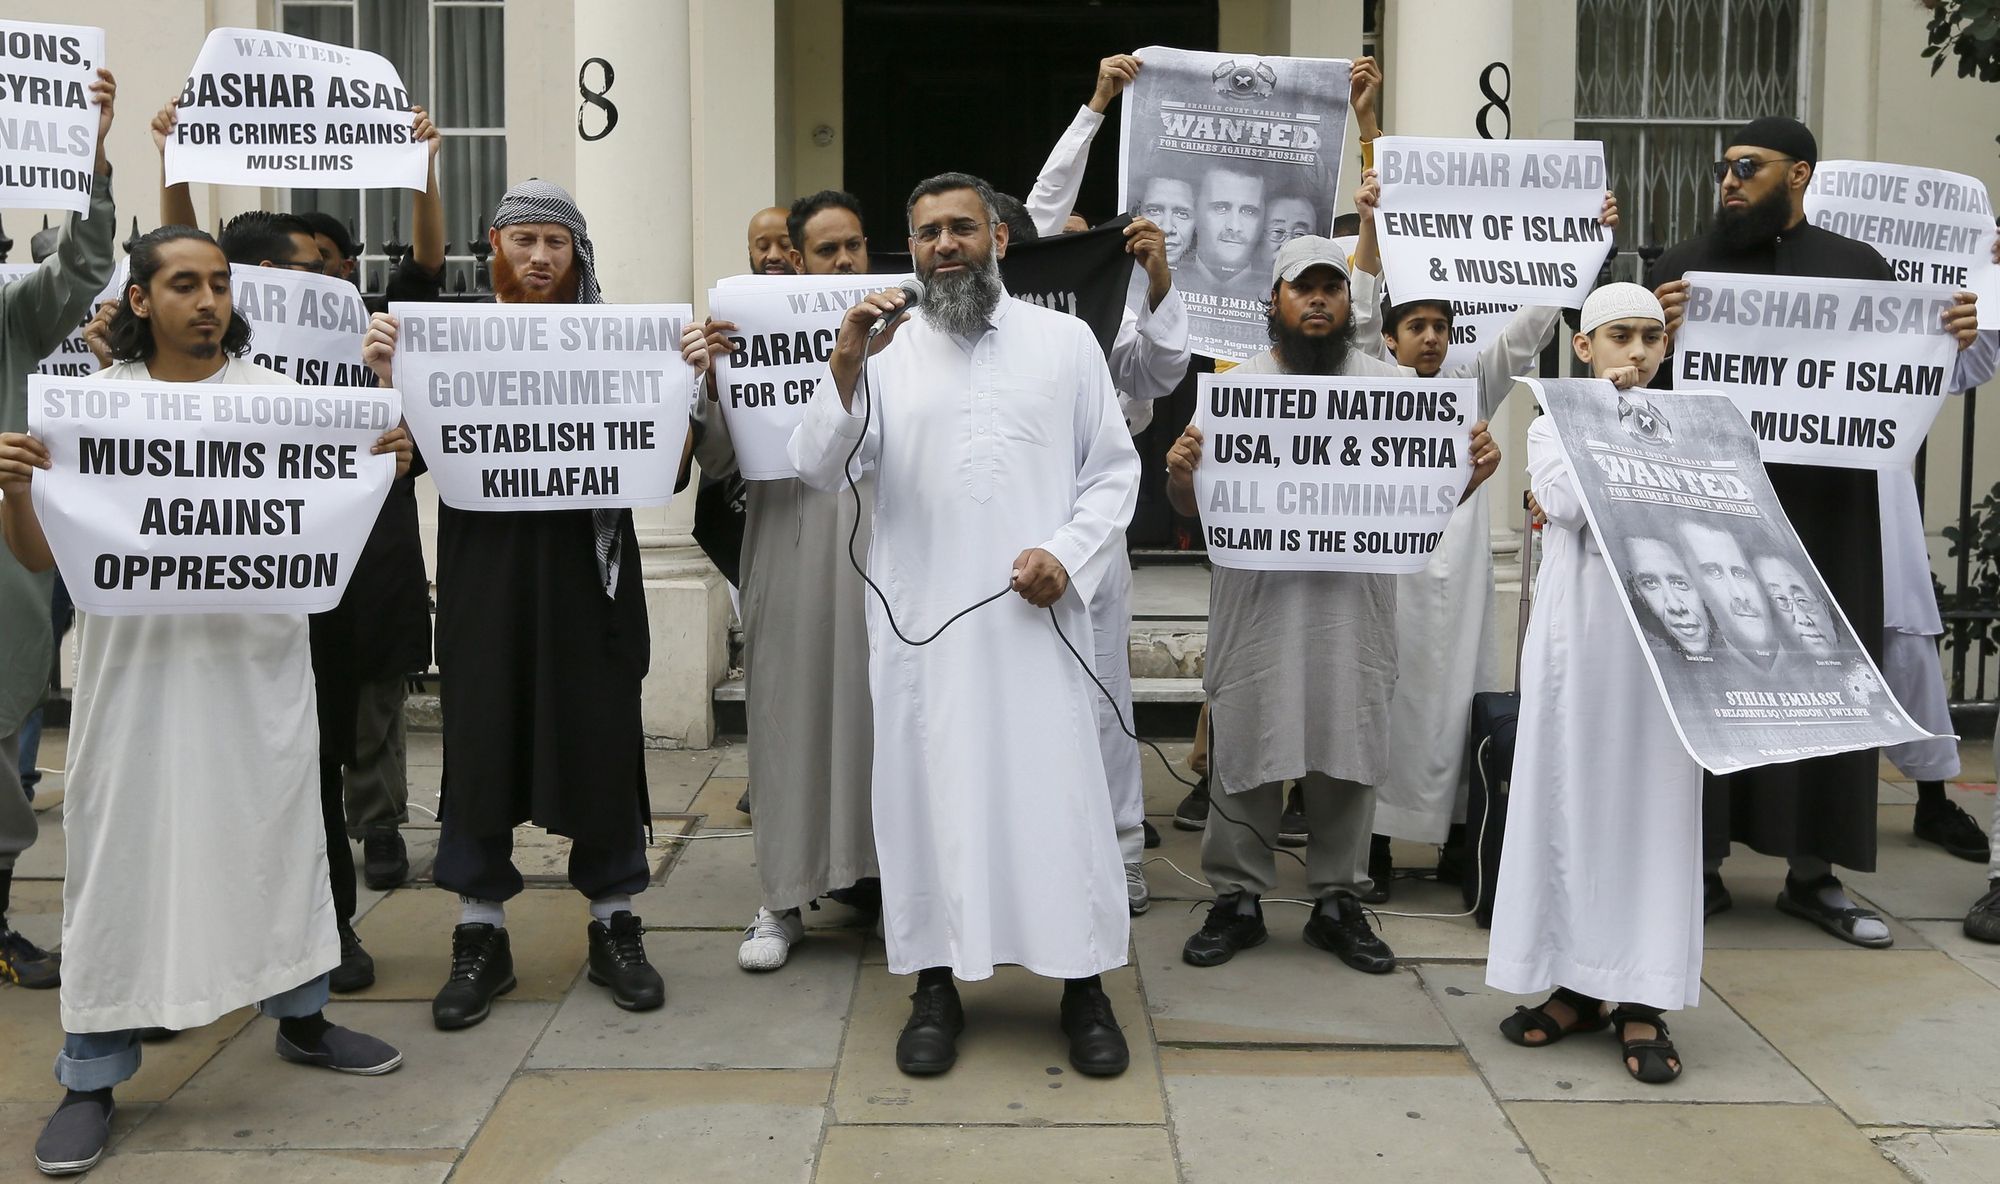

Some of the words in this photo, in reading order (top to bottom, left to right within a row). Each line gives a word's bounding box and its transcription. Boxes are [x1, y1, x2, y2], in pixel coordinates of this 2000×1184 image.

[234, 38, 351, 65] WANTED:
[178, 73, 313, 109] BASHAR
[327, 76, 412, 112] ASAD
[578, 57, 618, 141] 8
[1475, 61, 1511, 139] 8
[178, 123, 221, 145] FOR
[229, 123, 317, 145] CRIMES
[325, 123, 419, 145] AGAINST
[1160, 112, 1321, 149] WANTED
[246, 155, 353, 171] MUSLIMS
[1159, 138, 1178, 148] FOR
[1180, 140, 1218, 153] CRIMES
[1220, 145, 1265, 158] AGAINST
[1267, 150, 1315, 163] MUSLIMS
[1382, 150, 1510, 188] BASHAR
[1520, 153, 1603, 190] ASAD
[1915, 180, 1993, 216] SYRIAN
[1384, 212, 1473, 239] ENEMY
[1483, 214, 1513, 241] OF
[1523, 216, 1604, 242] ISLAM
[1815, 209, 1982, 254] GOVERNMENT
[1429, 257, 1448, 282] &
[1455, 258, 1578, 288] MUSLIMS
[1931, 263, 1968, 288] THE
[1218, 308, 1252, 319] LONDON
[1687, 286, 1839, 331] BASHAR
[1848, 296, 1953, 336] ASAD
[404, 316, 549, 353] REMOVE
[560, 316, 682, 353] SYRIAN
[728, 328, 840, 368] BARAC
[1224, 339, 1257, 350] August
[428, 370, 664, 408] GOVERNMENT
[1683, 350, 1788, 387] ENEMY
[1797, 358, 1836, 390] OF
[1846, 361, 1944, 396] ISLAM
[43, 389, 130, 419] STOP
[141, 391, 202, 421] THE
[214, 395, 390, 430] BLOODSHED
[730, 381, 775, 409] FOR
[1210, 387, 1317, 419] UNITED
[1327, 389, 1464, 426] NATIONS,
[441, 421, 594, 454] ESTABLISH
[604, 420, 655, 450] THE
[1751, 410, 1897, 449] MUSLIMS
[79, 437, 265, 478] MUSLIMS
[278, 444, 357, 479] RISE
[1214, 433, 1280, 468] USA,
[1291, 435, 1331, 465] UK
[1340, 436, 1361, 466] &
[1370, 436, 1456, 468] SYRIA
[482, 465, 620, 498] KHILAFAH
[1592, 454, 1753, 501] WANTED
[140, 498, 305, 535] AGAINST
[1209, 480, 1265, 514] ALL
[1276, 481, 1455, 517] CRIMINALS
[1608, 486, 1629, 498] FOR
[1632, 488, 1670, 502] CRIMES
[1672, 494, 1713, 510] AGAINST
[1715, 501, 1758, 516] MUSLIMS
[1208, 525, 1272, 551] ISLAM
[1280, 529, 1300, 552] IS
[1307, 530, 1346, 553] THE
[93, 553, 339, 590] OPPRESSION
[1725, 691, 1779, 707] SYRIAN
[1780, 691, 1845, 706] EMBASSY
[1783, 708, 1824, 718] LONDON
